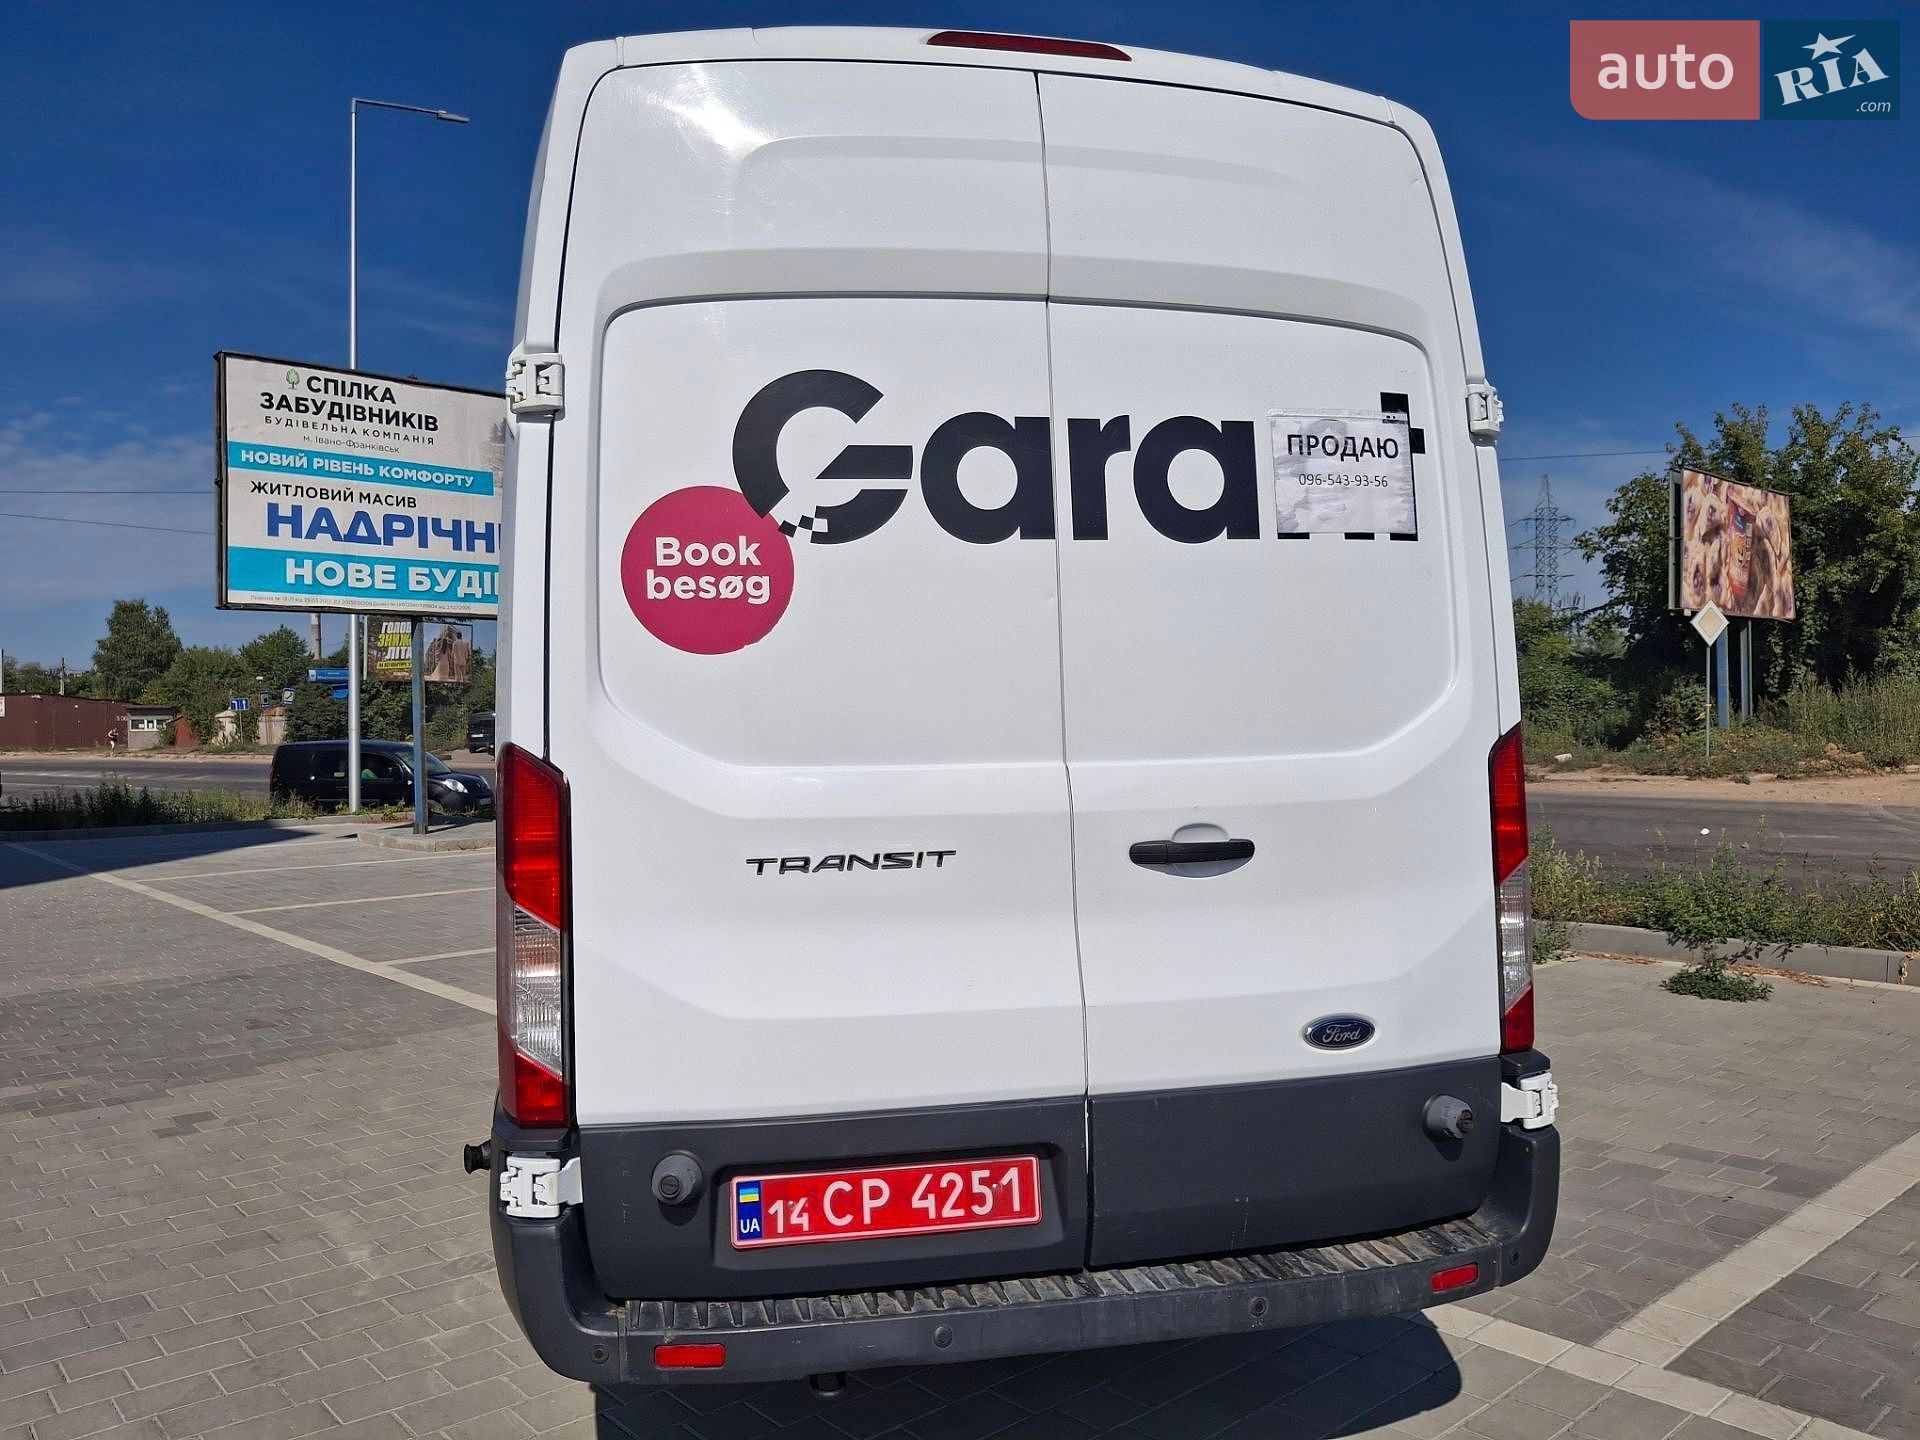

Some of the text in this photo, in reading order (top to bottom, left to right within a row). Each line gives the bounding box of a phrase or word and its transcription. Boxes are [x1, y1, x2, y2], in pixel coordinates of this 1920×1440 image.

[306, 375, 396, 404] СПІЛКА
[260, 392, 439, 432] ЗАБУДІВНИКІВ
[264, 415, 435, 446] БУДІВЕЛЬНА КОМПАНІЯ
[314, 435, 400, 454] Івано-Франківськ
[1287, 434, 1399, 462] ПРОДАЮ
[240, 449, 475, 488] НОВИЙ РІВЕНЬ КОМФОРТУ
[1299, 473, 1388, 488] 096-543-93-56
[250, 480, 417, 508] ЖИТЛОВИЙ МАСИВ
[267, 502, 501, 553] НАДРІЧН
[655, 535, 762, 566] Book
[285, 558, 396, 590] НОВЕ
[646, 569, 771, 605] besøg
[377, 633, 412, 647] ЗНИЖ
[746, 850, 957, 876] TRANSIT
[1322, 1023, 1361, 1043] Ford
[740, 1167, 1021, 1234] UA 14 CP 4251
